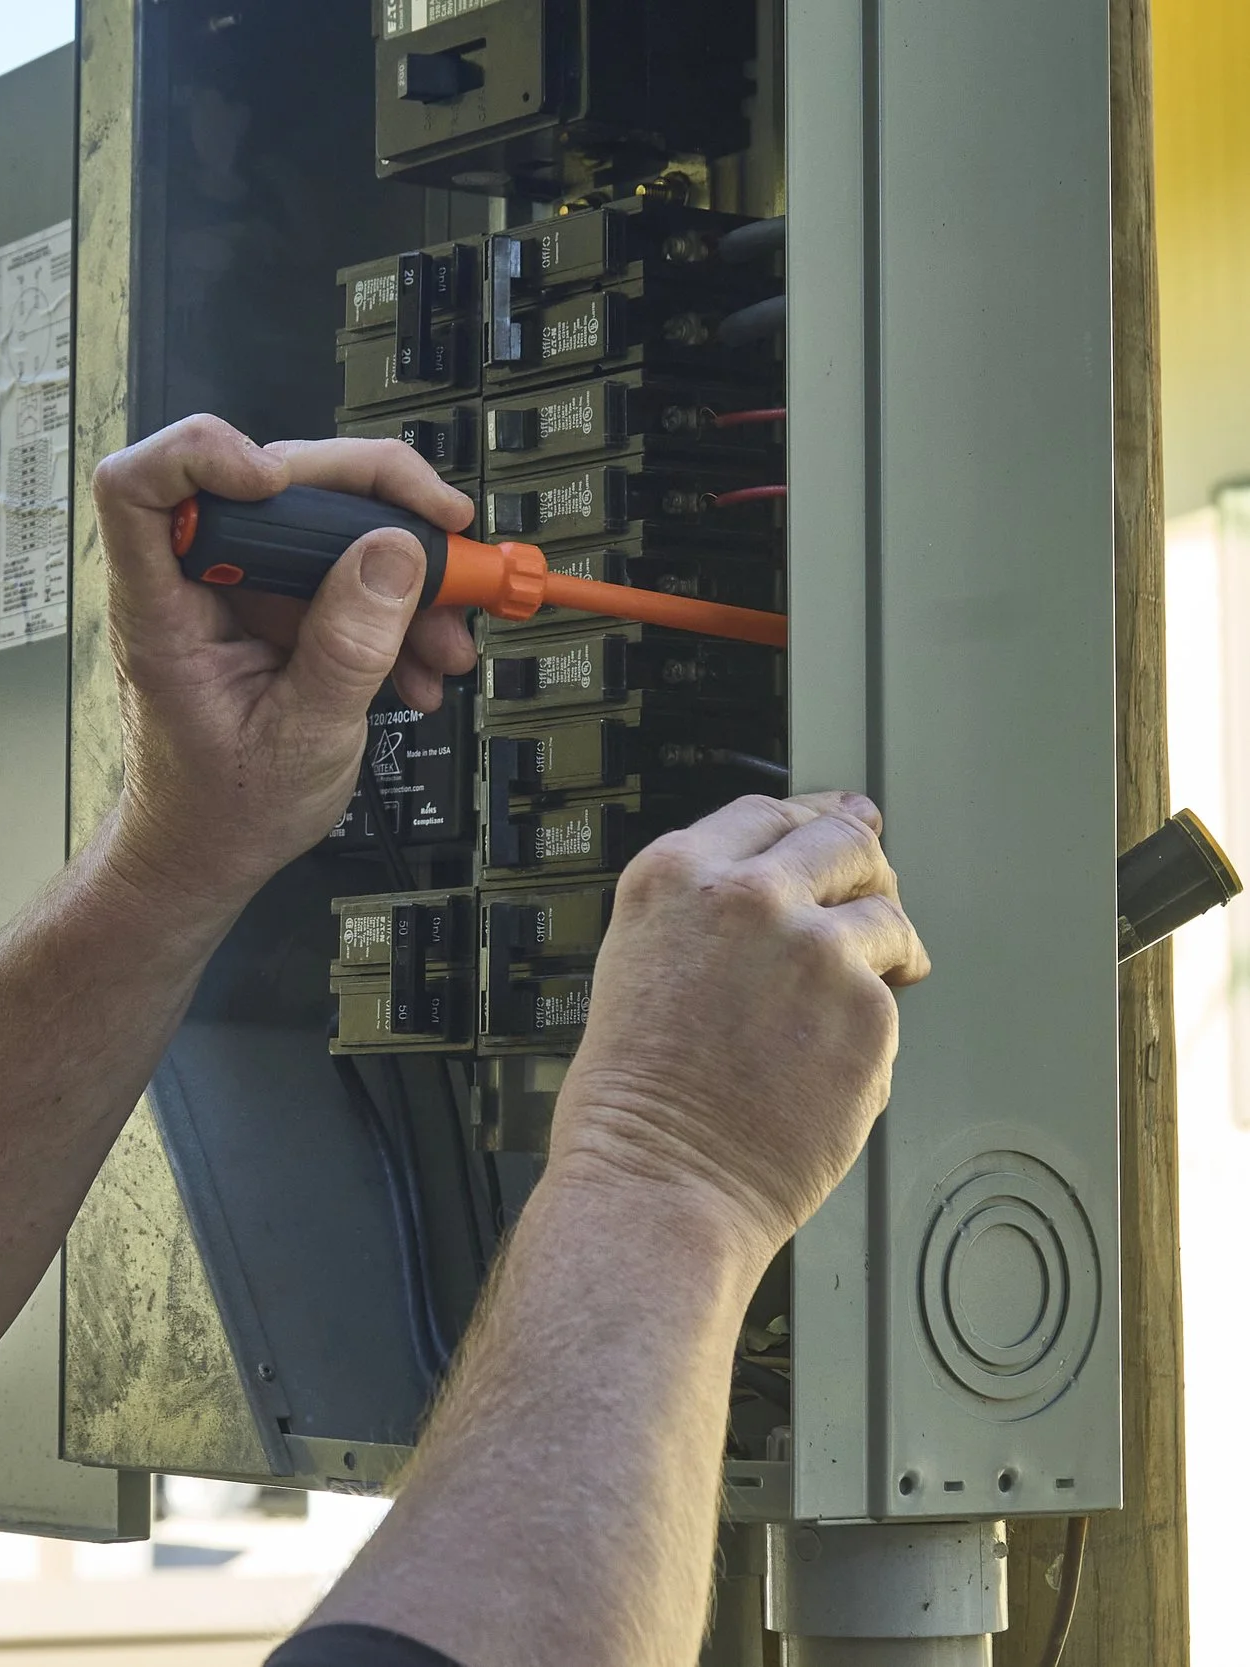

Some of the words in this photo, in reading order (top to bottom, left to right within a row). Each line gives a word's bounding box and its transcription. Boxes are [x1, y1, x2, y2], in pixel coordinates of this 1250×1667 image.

[404, 269, 414, 286] 20
[401, 347, 411, 365] 20
[404, 430, 415, 446] 20
[438, 746, 451, 756] USA
[398, 920, 409, 936] 50
[398, 1004, 408, 1020] 50
